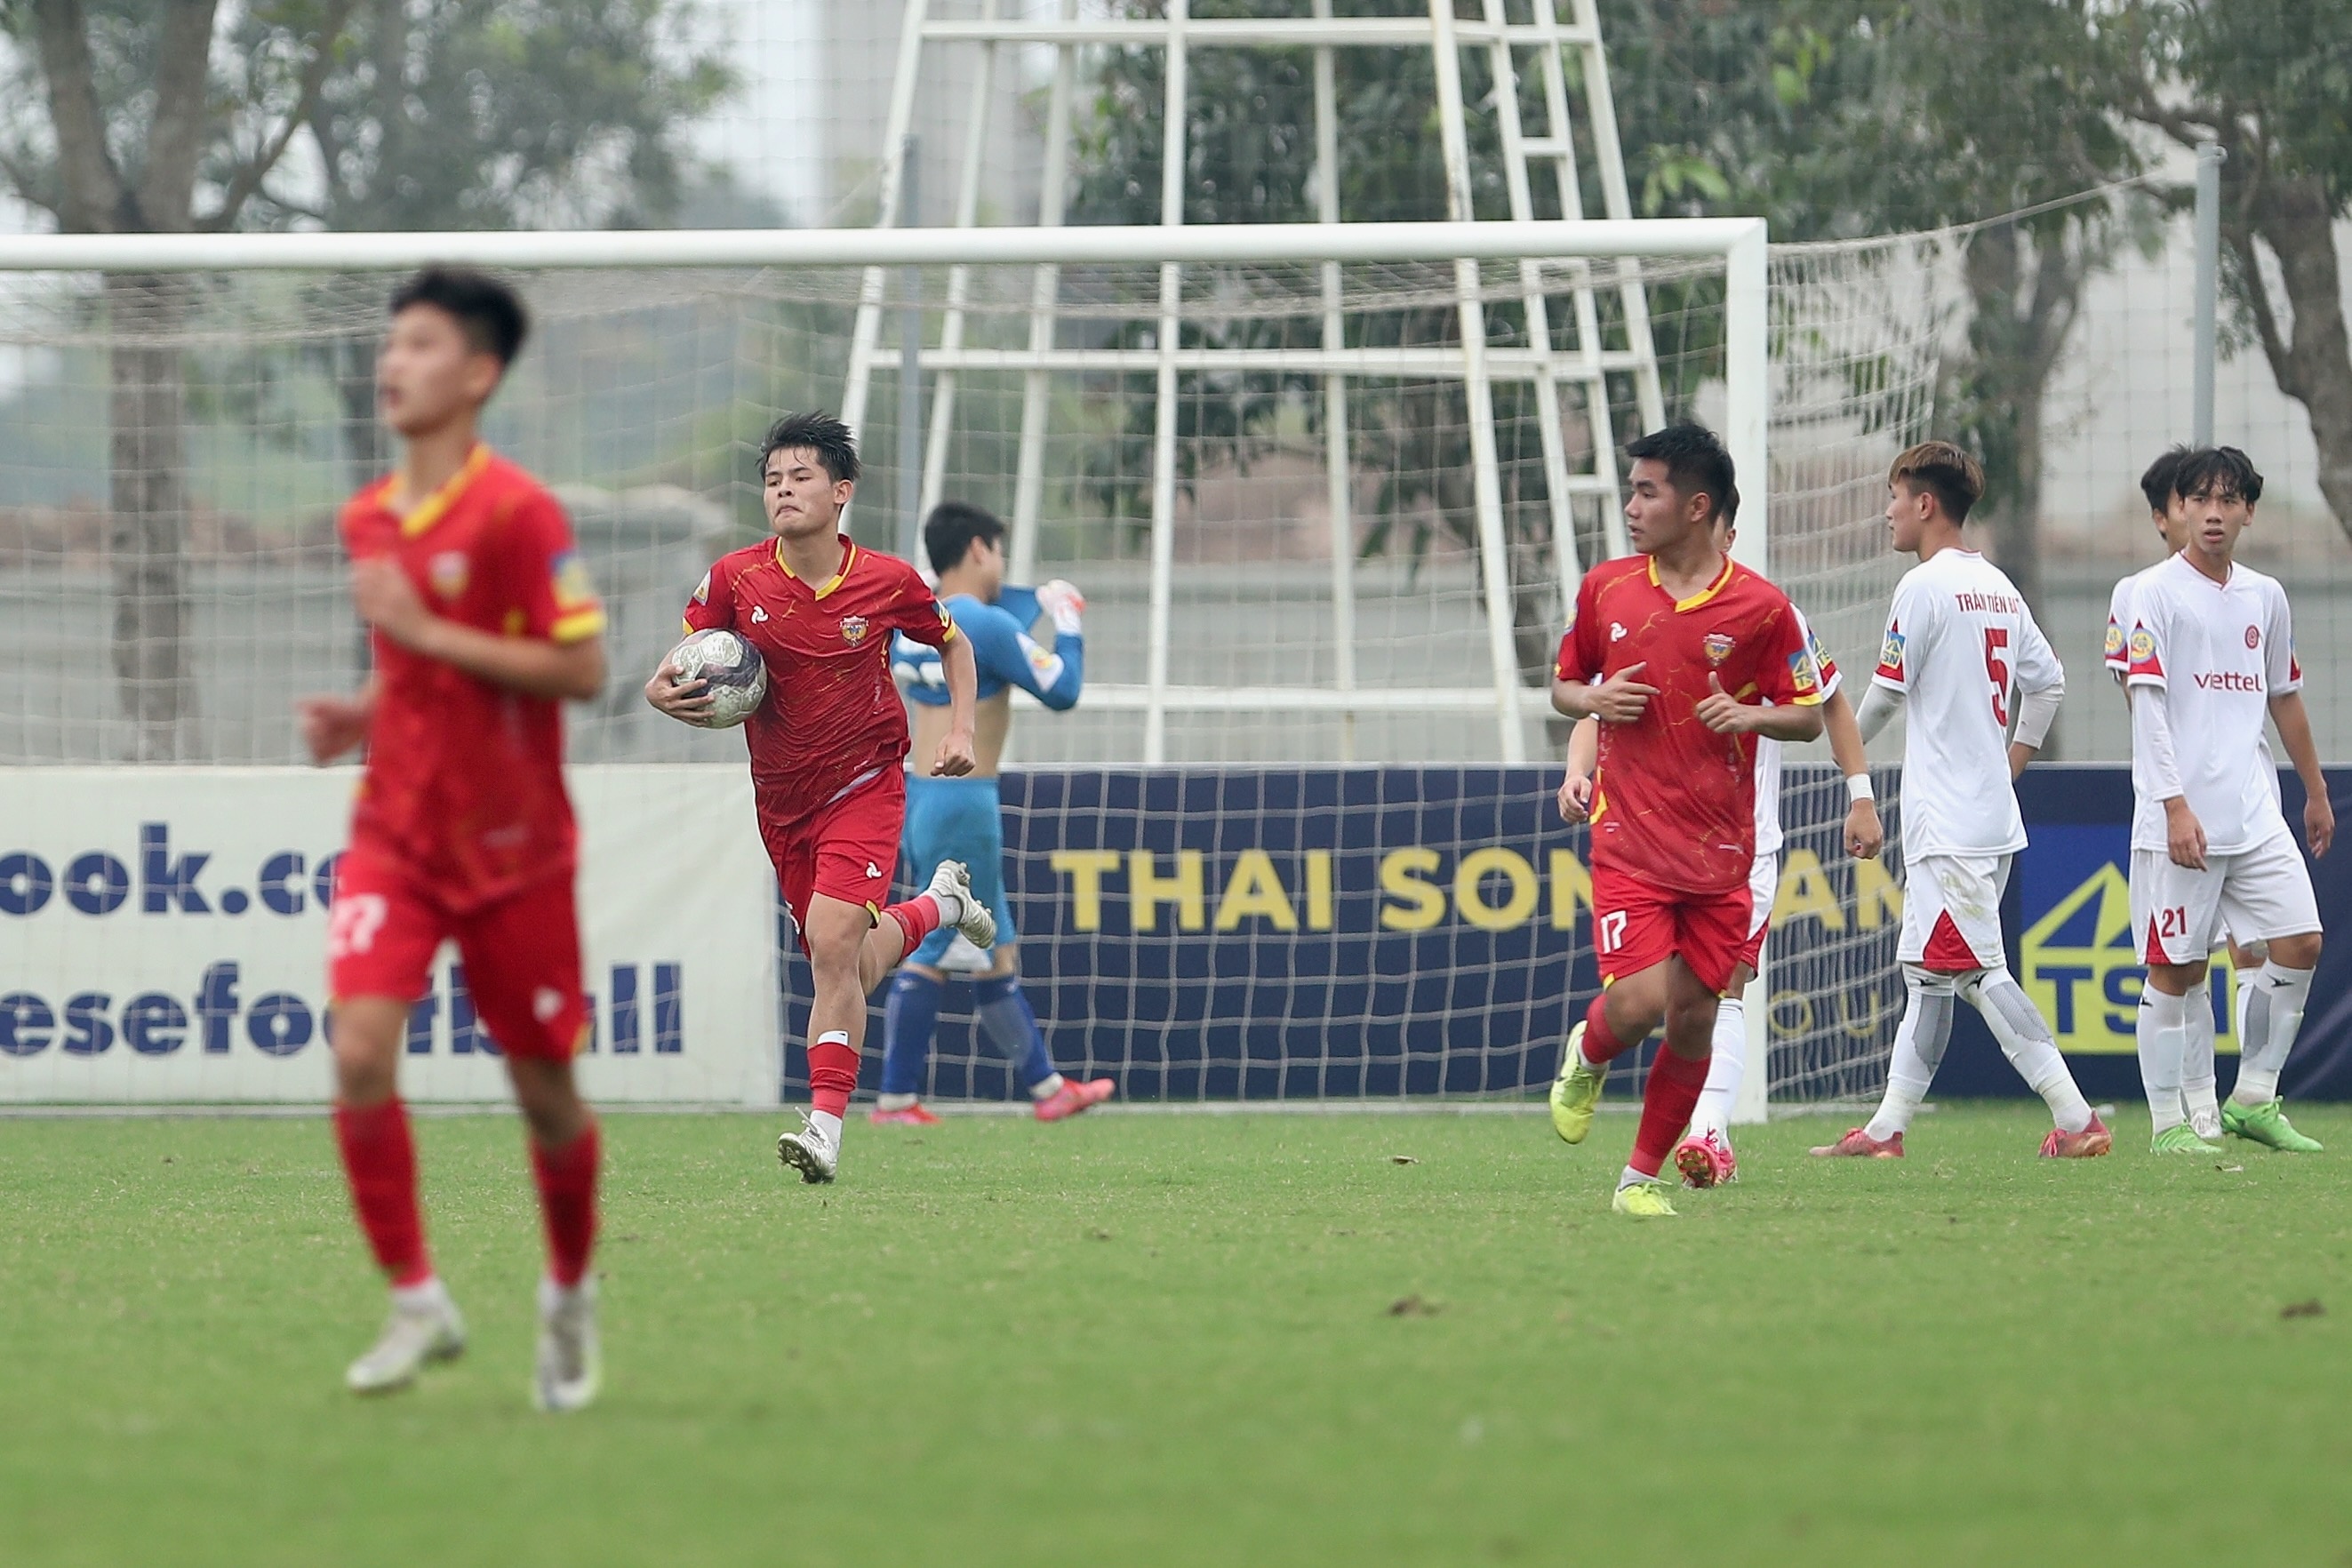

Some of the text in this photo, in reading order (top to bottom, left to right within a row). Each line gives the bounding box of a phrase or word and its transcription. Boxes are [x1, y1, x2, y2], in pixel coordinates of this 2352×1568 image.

[1984, 627, 2008, 727] 5
[2193, 669, 2263, 693] viettel
[1051, 848, 1332, 932] THAI
[1600, 909, 1628, 955] 17
[2161, 905, 2187, 938] 21
